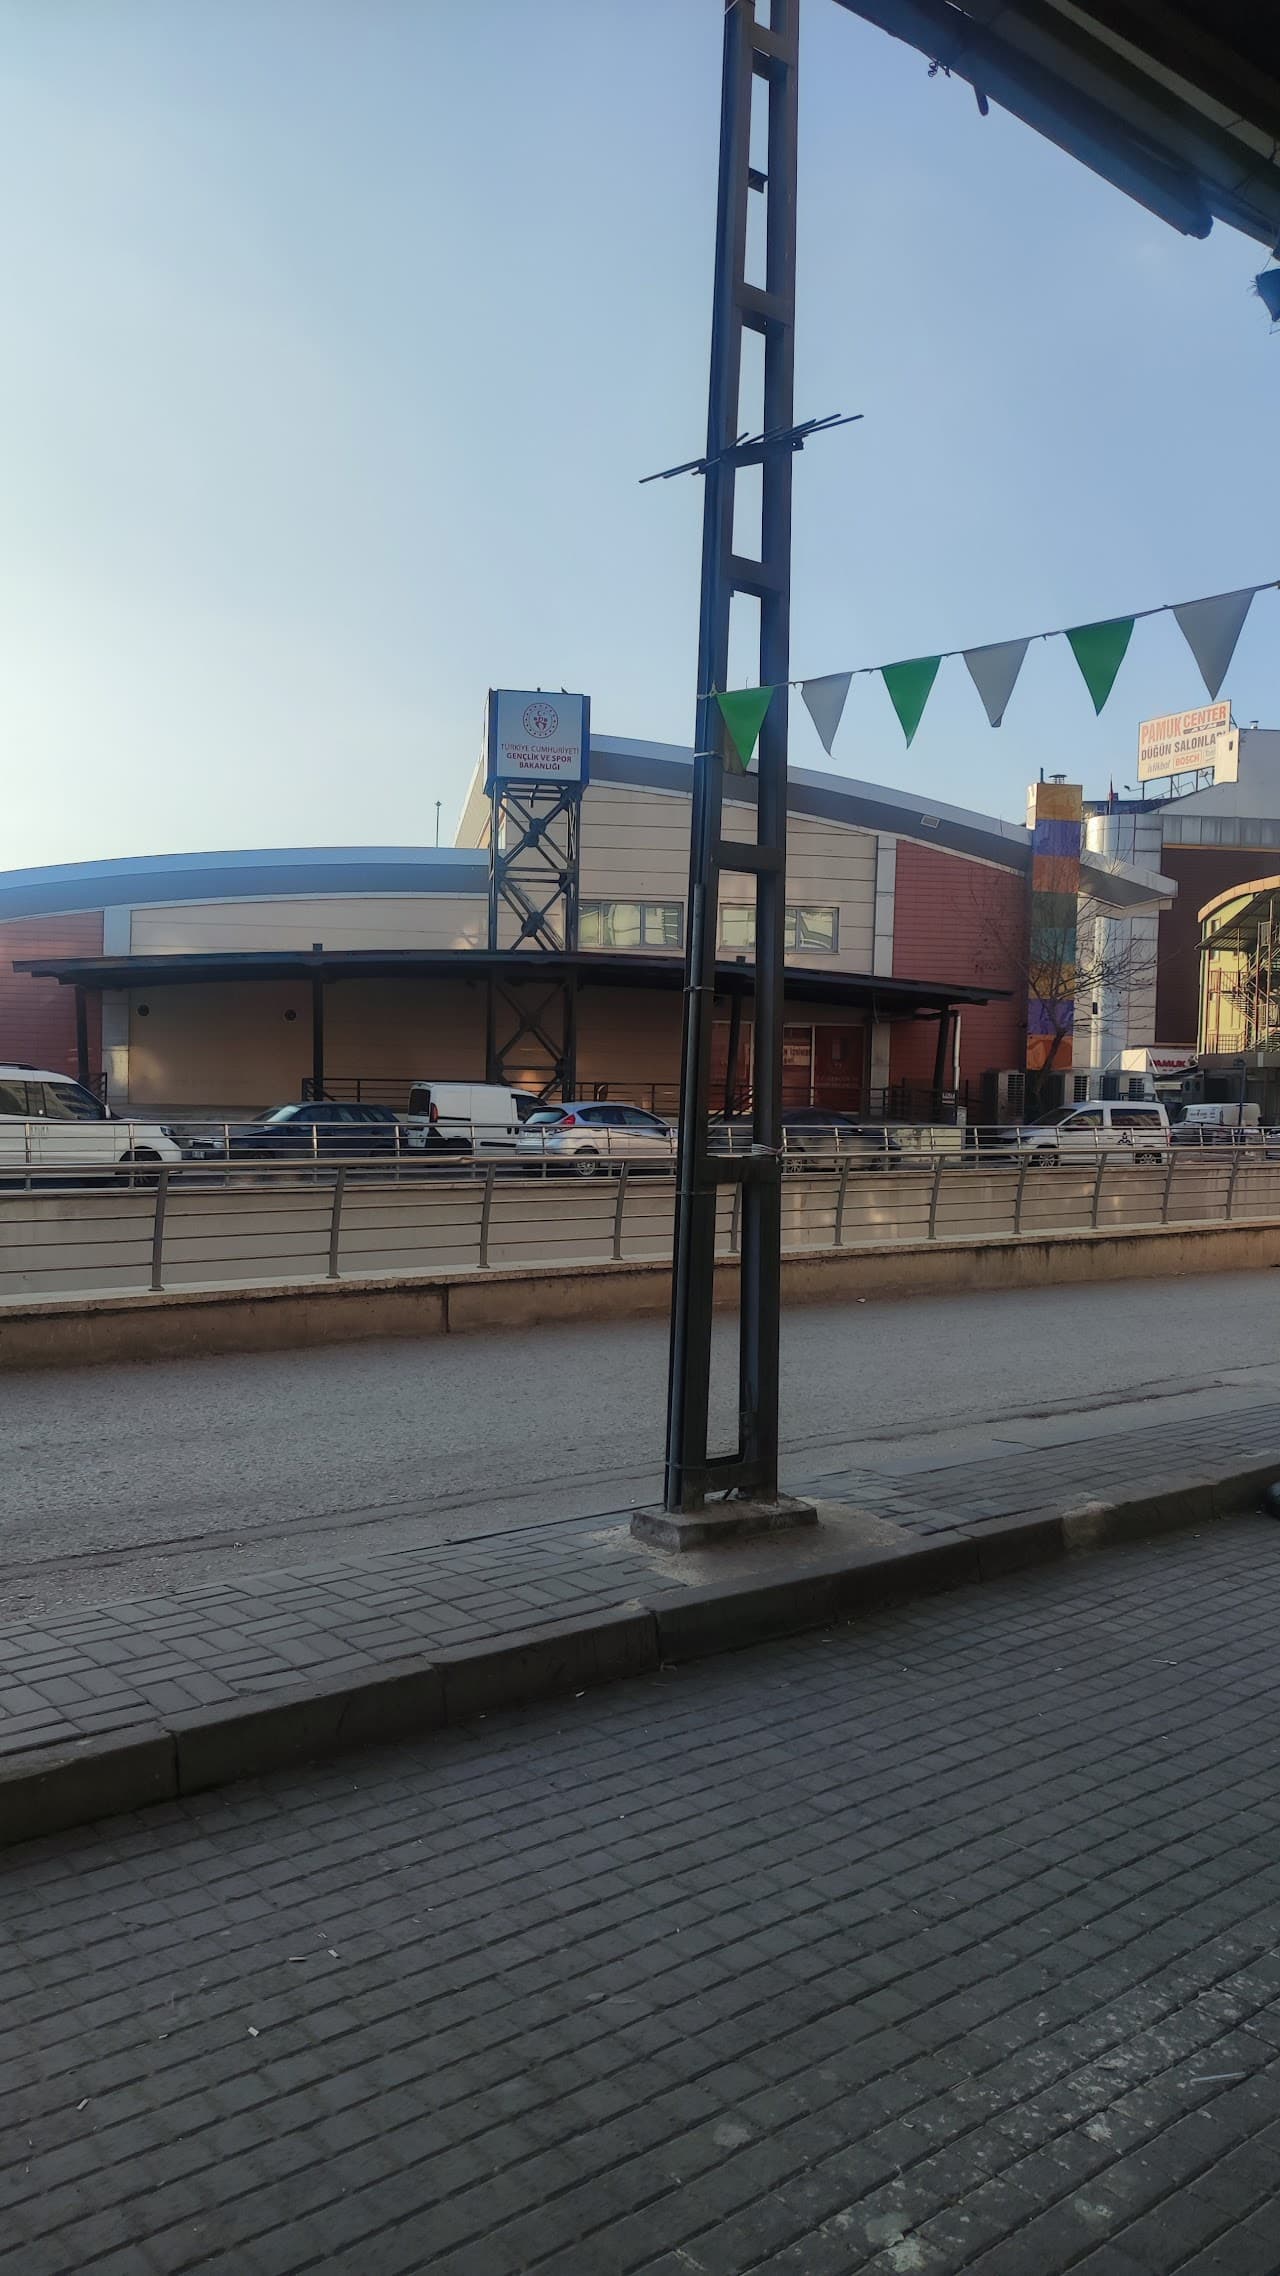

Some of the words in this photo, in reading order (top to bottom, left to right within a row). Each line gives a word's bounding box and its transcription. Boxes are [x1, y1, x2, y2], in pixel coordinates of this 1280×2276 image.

[1142, 718, 1181, 745] PAMUK
[1184, 706, 1226, 728] CENTER
[507, 752, 538, 761] GENÇLİK
[552, 755, 572, 763] SPOR
[1175, 754, 1200, 766] BOSCH
